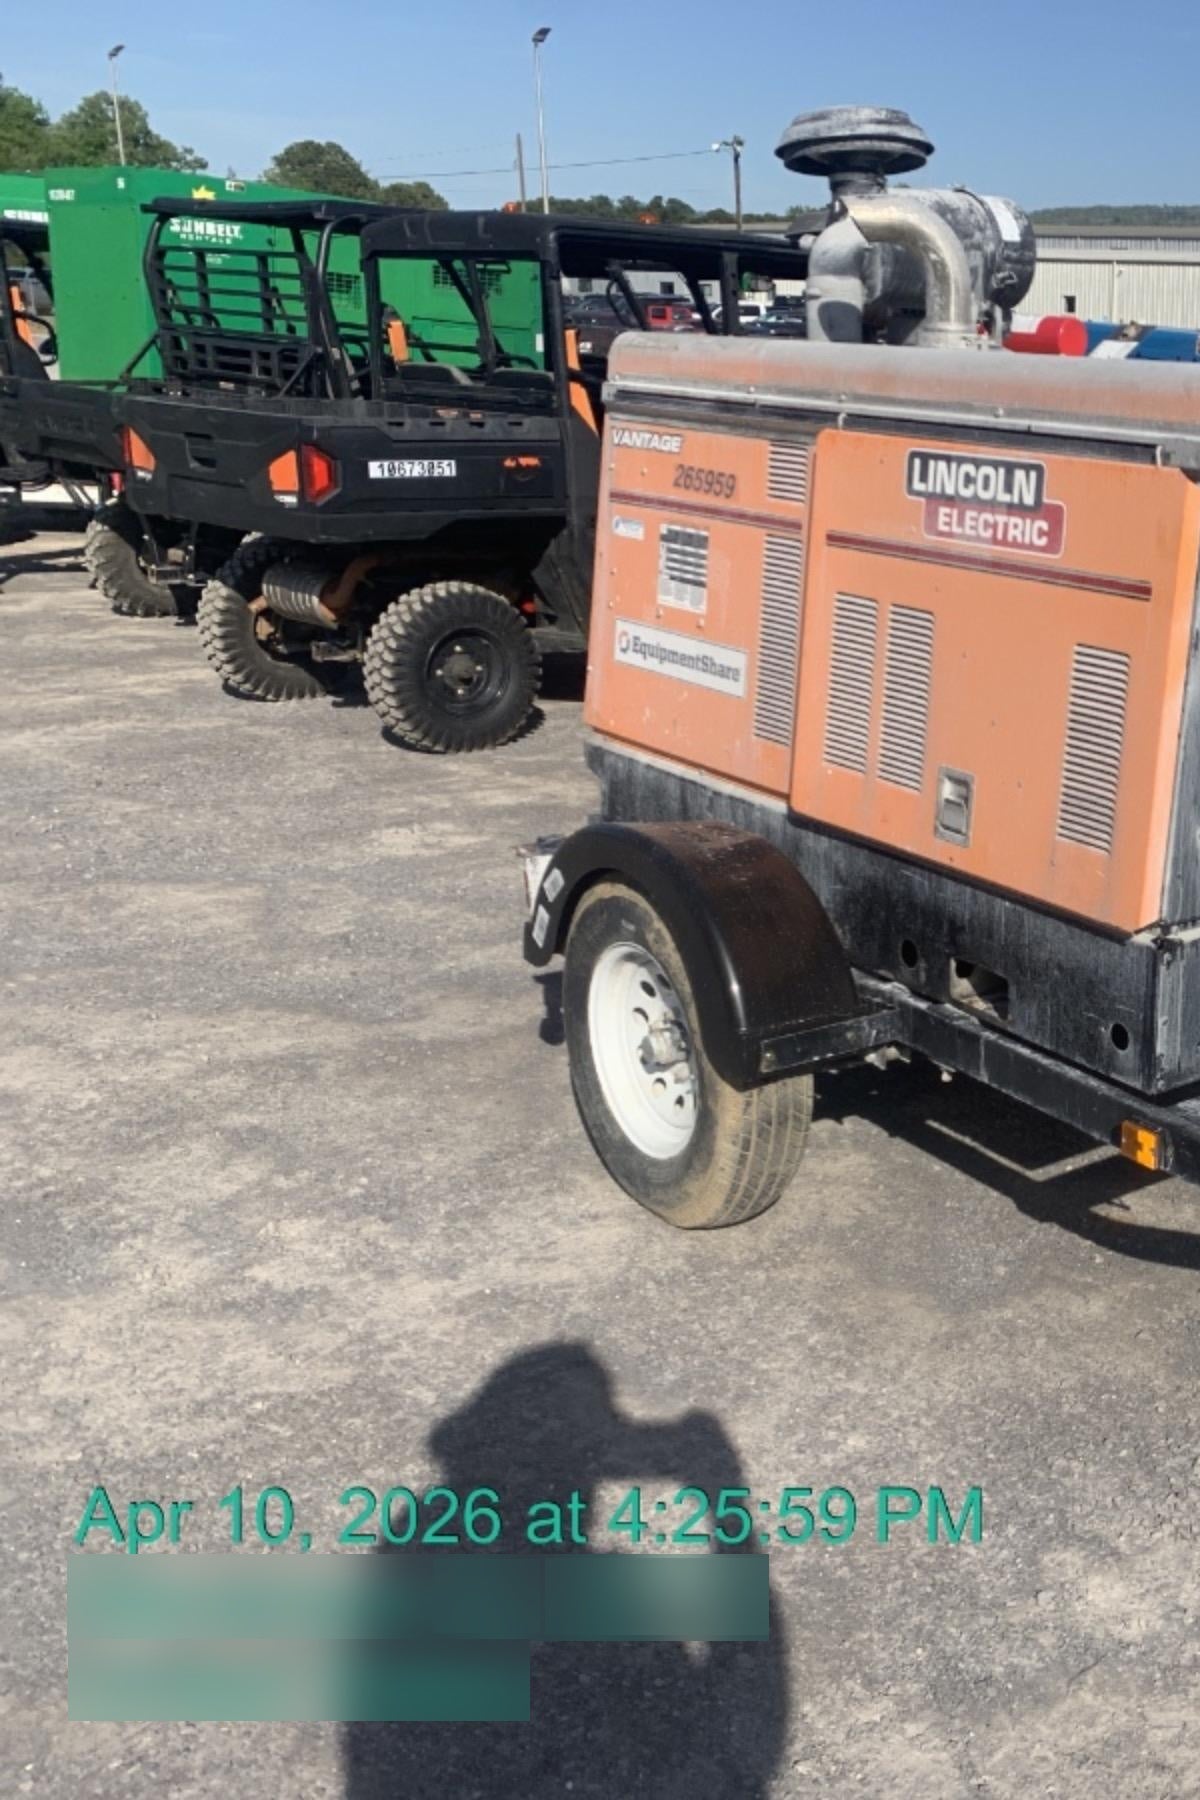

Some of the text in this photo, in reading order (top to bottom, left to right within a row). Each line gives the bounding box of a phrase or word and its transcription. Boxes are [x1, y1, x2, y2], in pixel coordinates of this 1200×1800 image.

[612, 428, 683, 454] VANTAGE
[672, 462, 738, 499] 265959
[912, 457, 1037, 507] LINCOLN
[937, 506, 1049, 547] ELECTRIC
[631, 634, 741, 683] EquipmentShare
